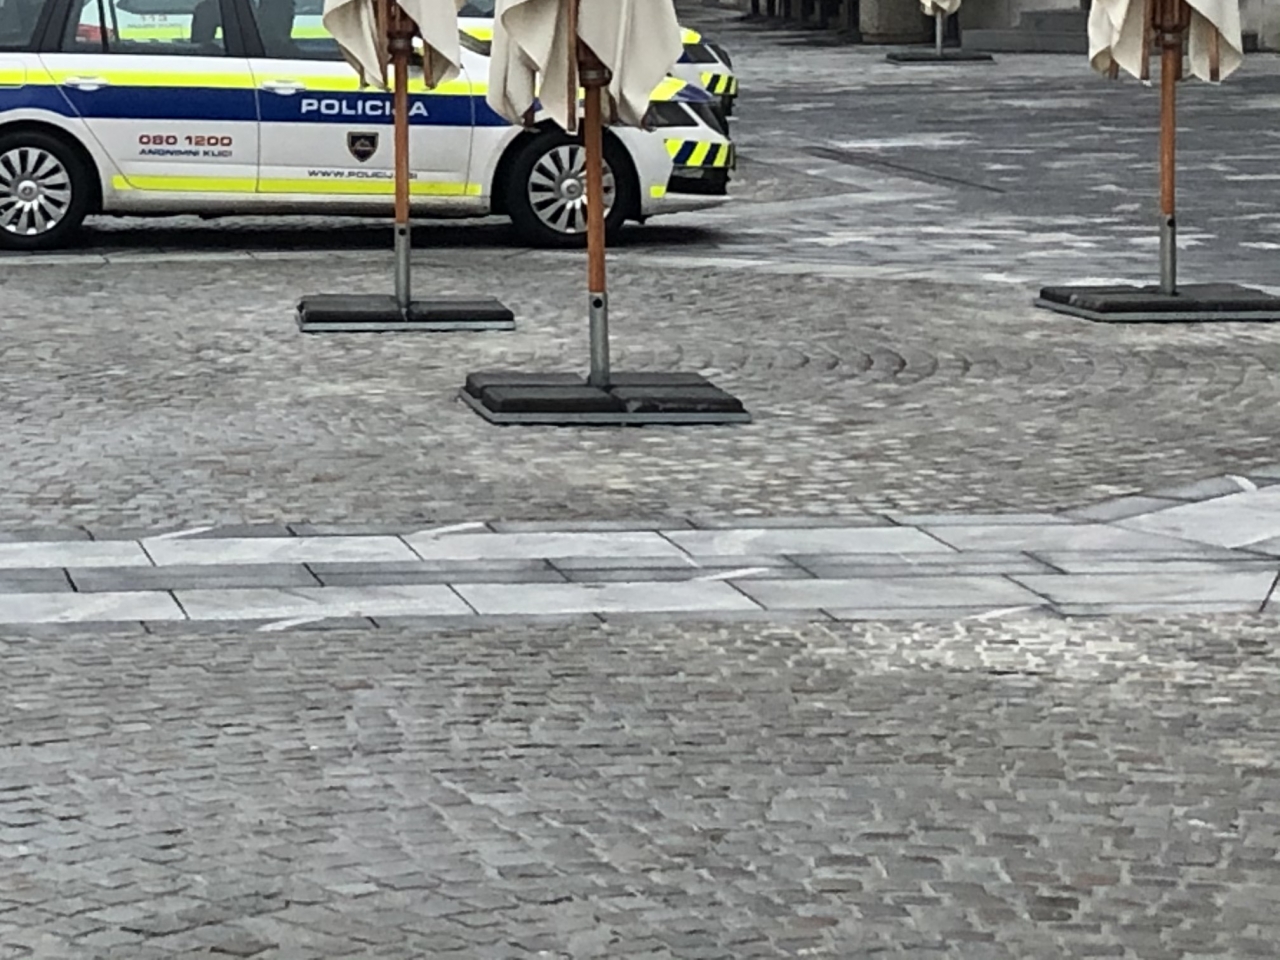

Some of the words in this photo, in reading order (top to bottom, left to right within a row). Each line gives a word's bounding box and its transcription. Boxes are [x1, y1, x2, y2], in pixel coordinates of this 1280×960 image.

[301, 98, 429, 117] POLICIA
[138, 134, 178, 146] 080
[184, 135, 233, 147] 1200
